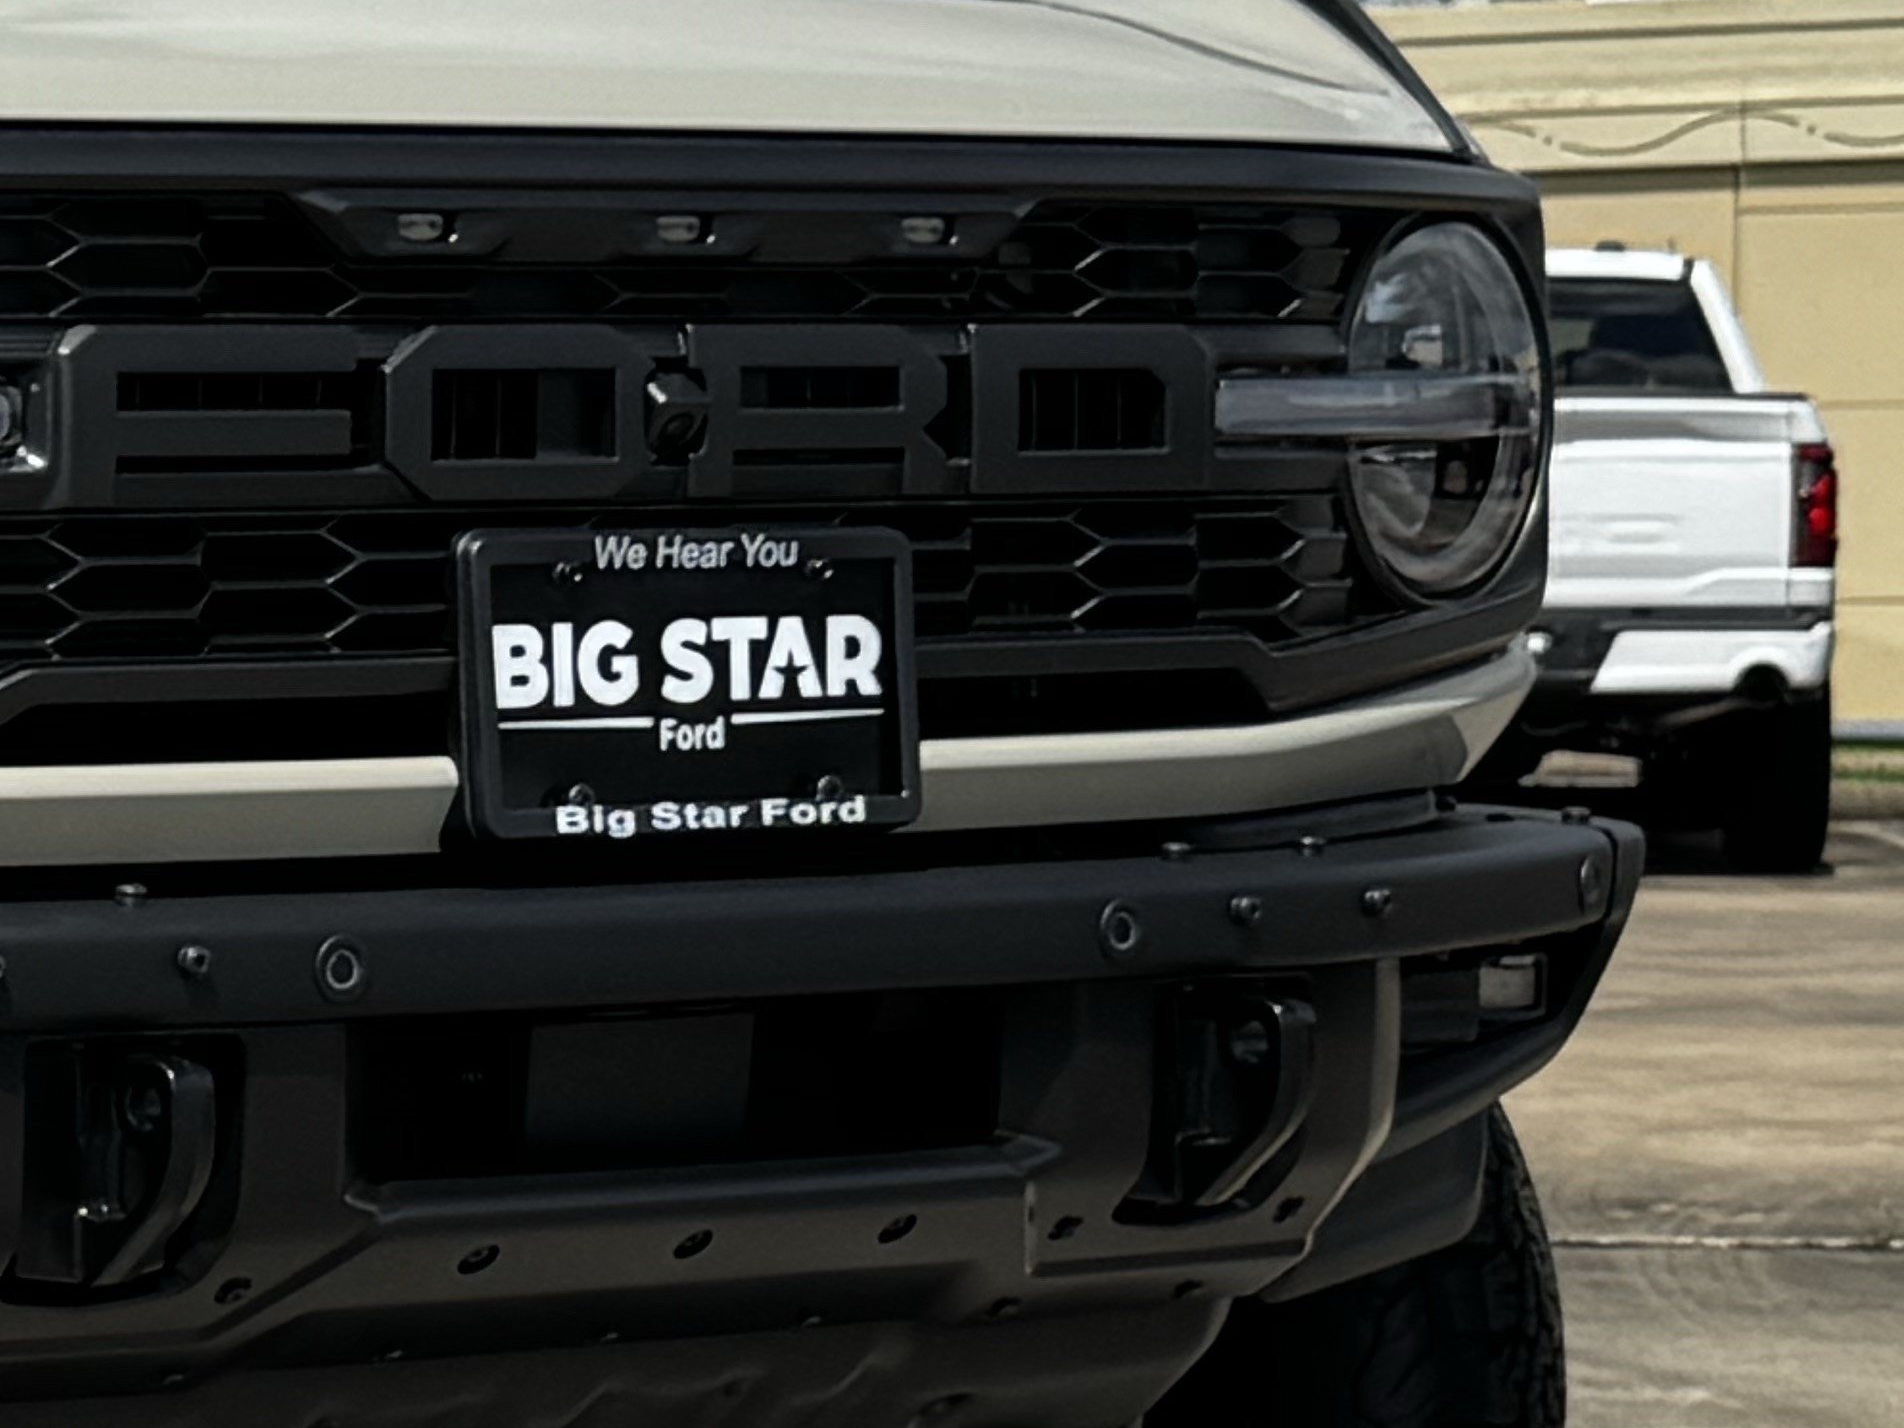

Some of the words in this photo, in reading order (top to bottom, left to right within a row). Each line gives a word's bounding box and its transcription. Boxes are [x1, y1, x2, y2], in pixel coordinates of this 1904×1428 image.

[46, 322, 1211, 506] FORD
[594, 535, 648, 571] We
[655, 533, 734, 570] Hear
[739, 532, 799, 568] You
[491, 619, 640, 709] BIG
[660, 614, 883, 704] STAR
[659, 716, 726, 751] Ford
[555, 803, 637, 839] Big
[650, 801, 750, 831] Star
[759, 794, 867, 827] Ford
